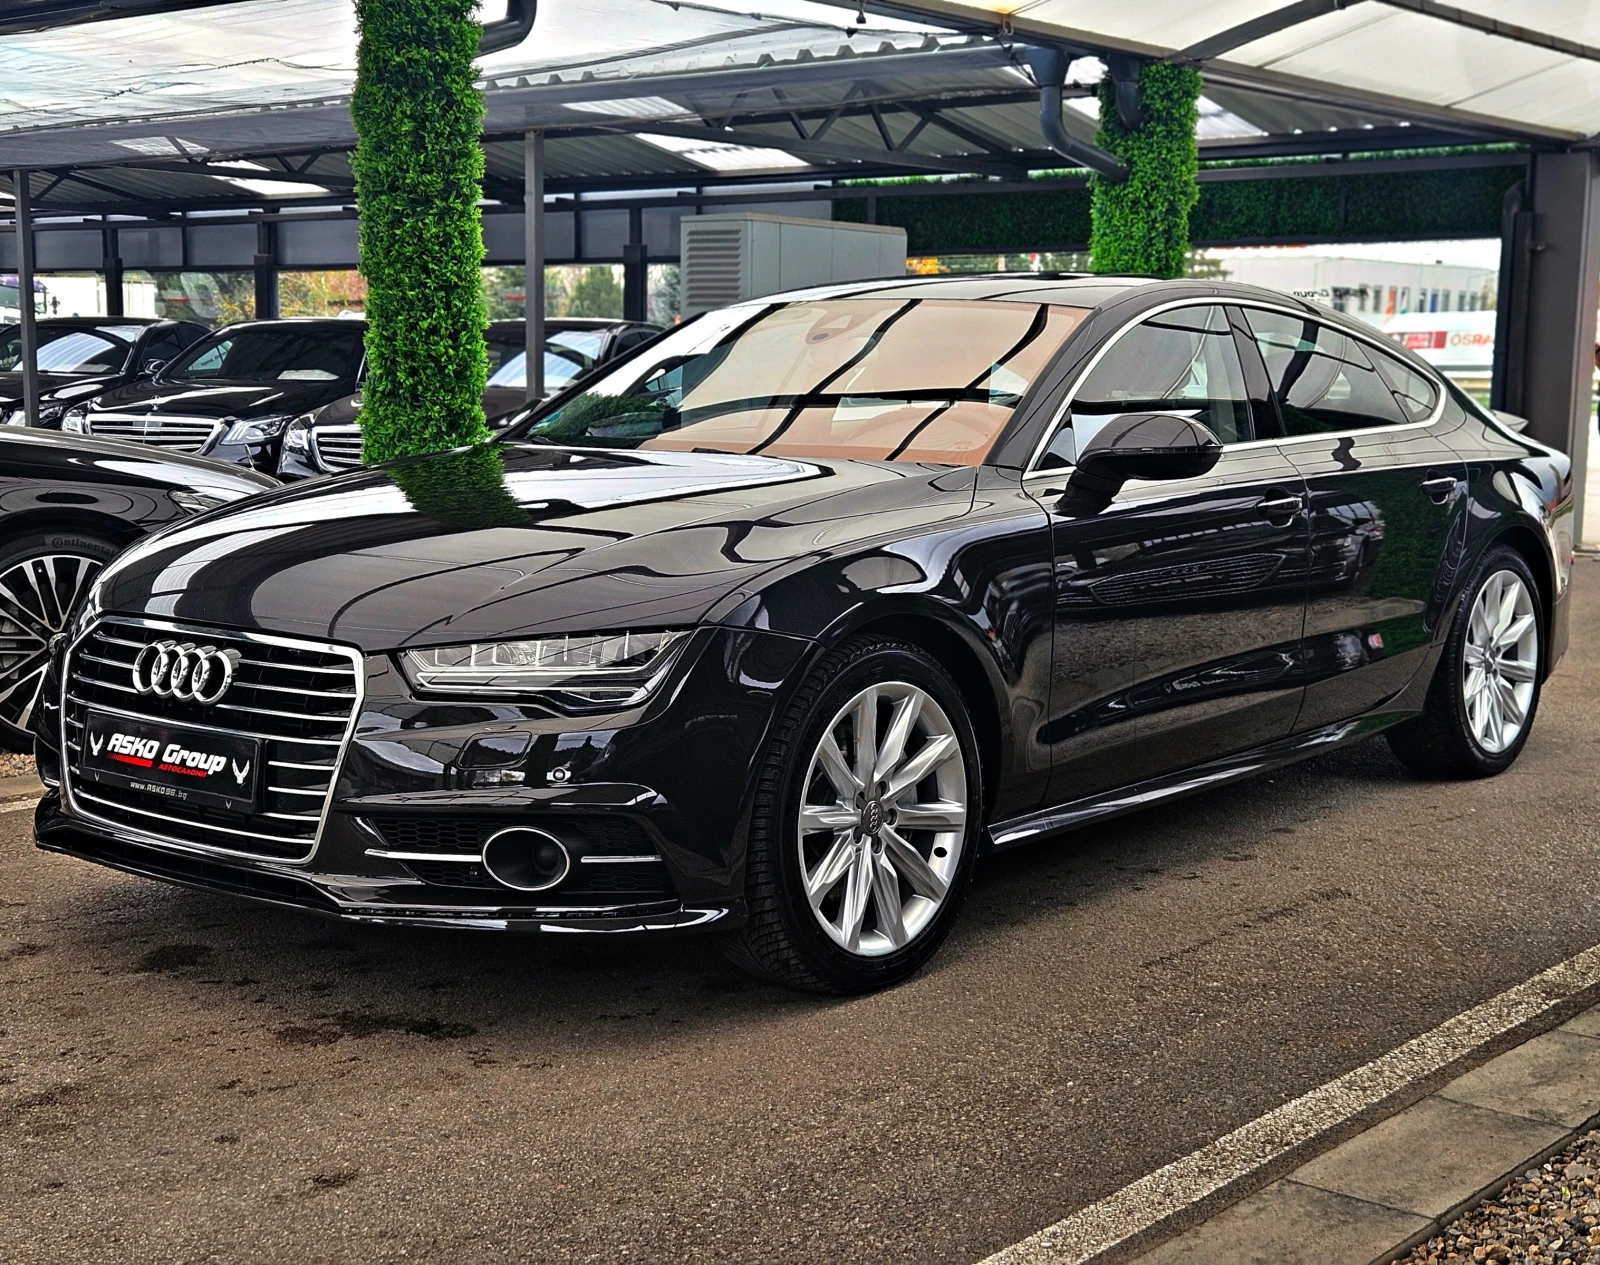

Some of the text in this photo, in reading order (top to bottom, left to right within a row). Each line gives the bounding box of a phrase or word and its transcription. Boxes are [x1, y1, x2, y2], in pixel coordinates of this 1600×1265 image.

[1450, 333, 1493, 346] OSRA
[51, 537, 115, 557] Continental
[162, 744, 227, 775] Group
[158, 763, 207, 778] АВТОСАЛОНИ
